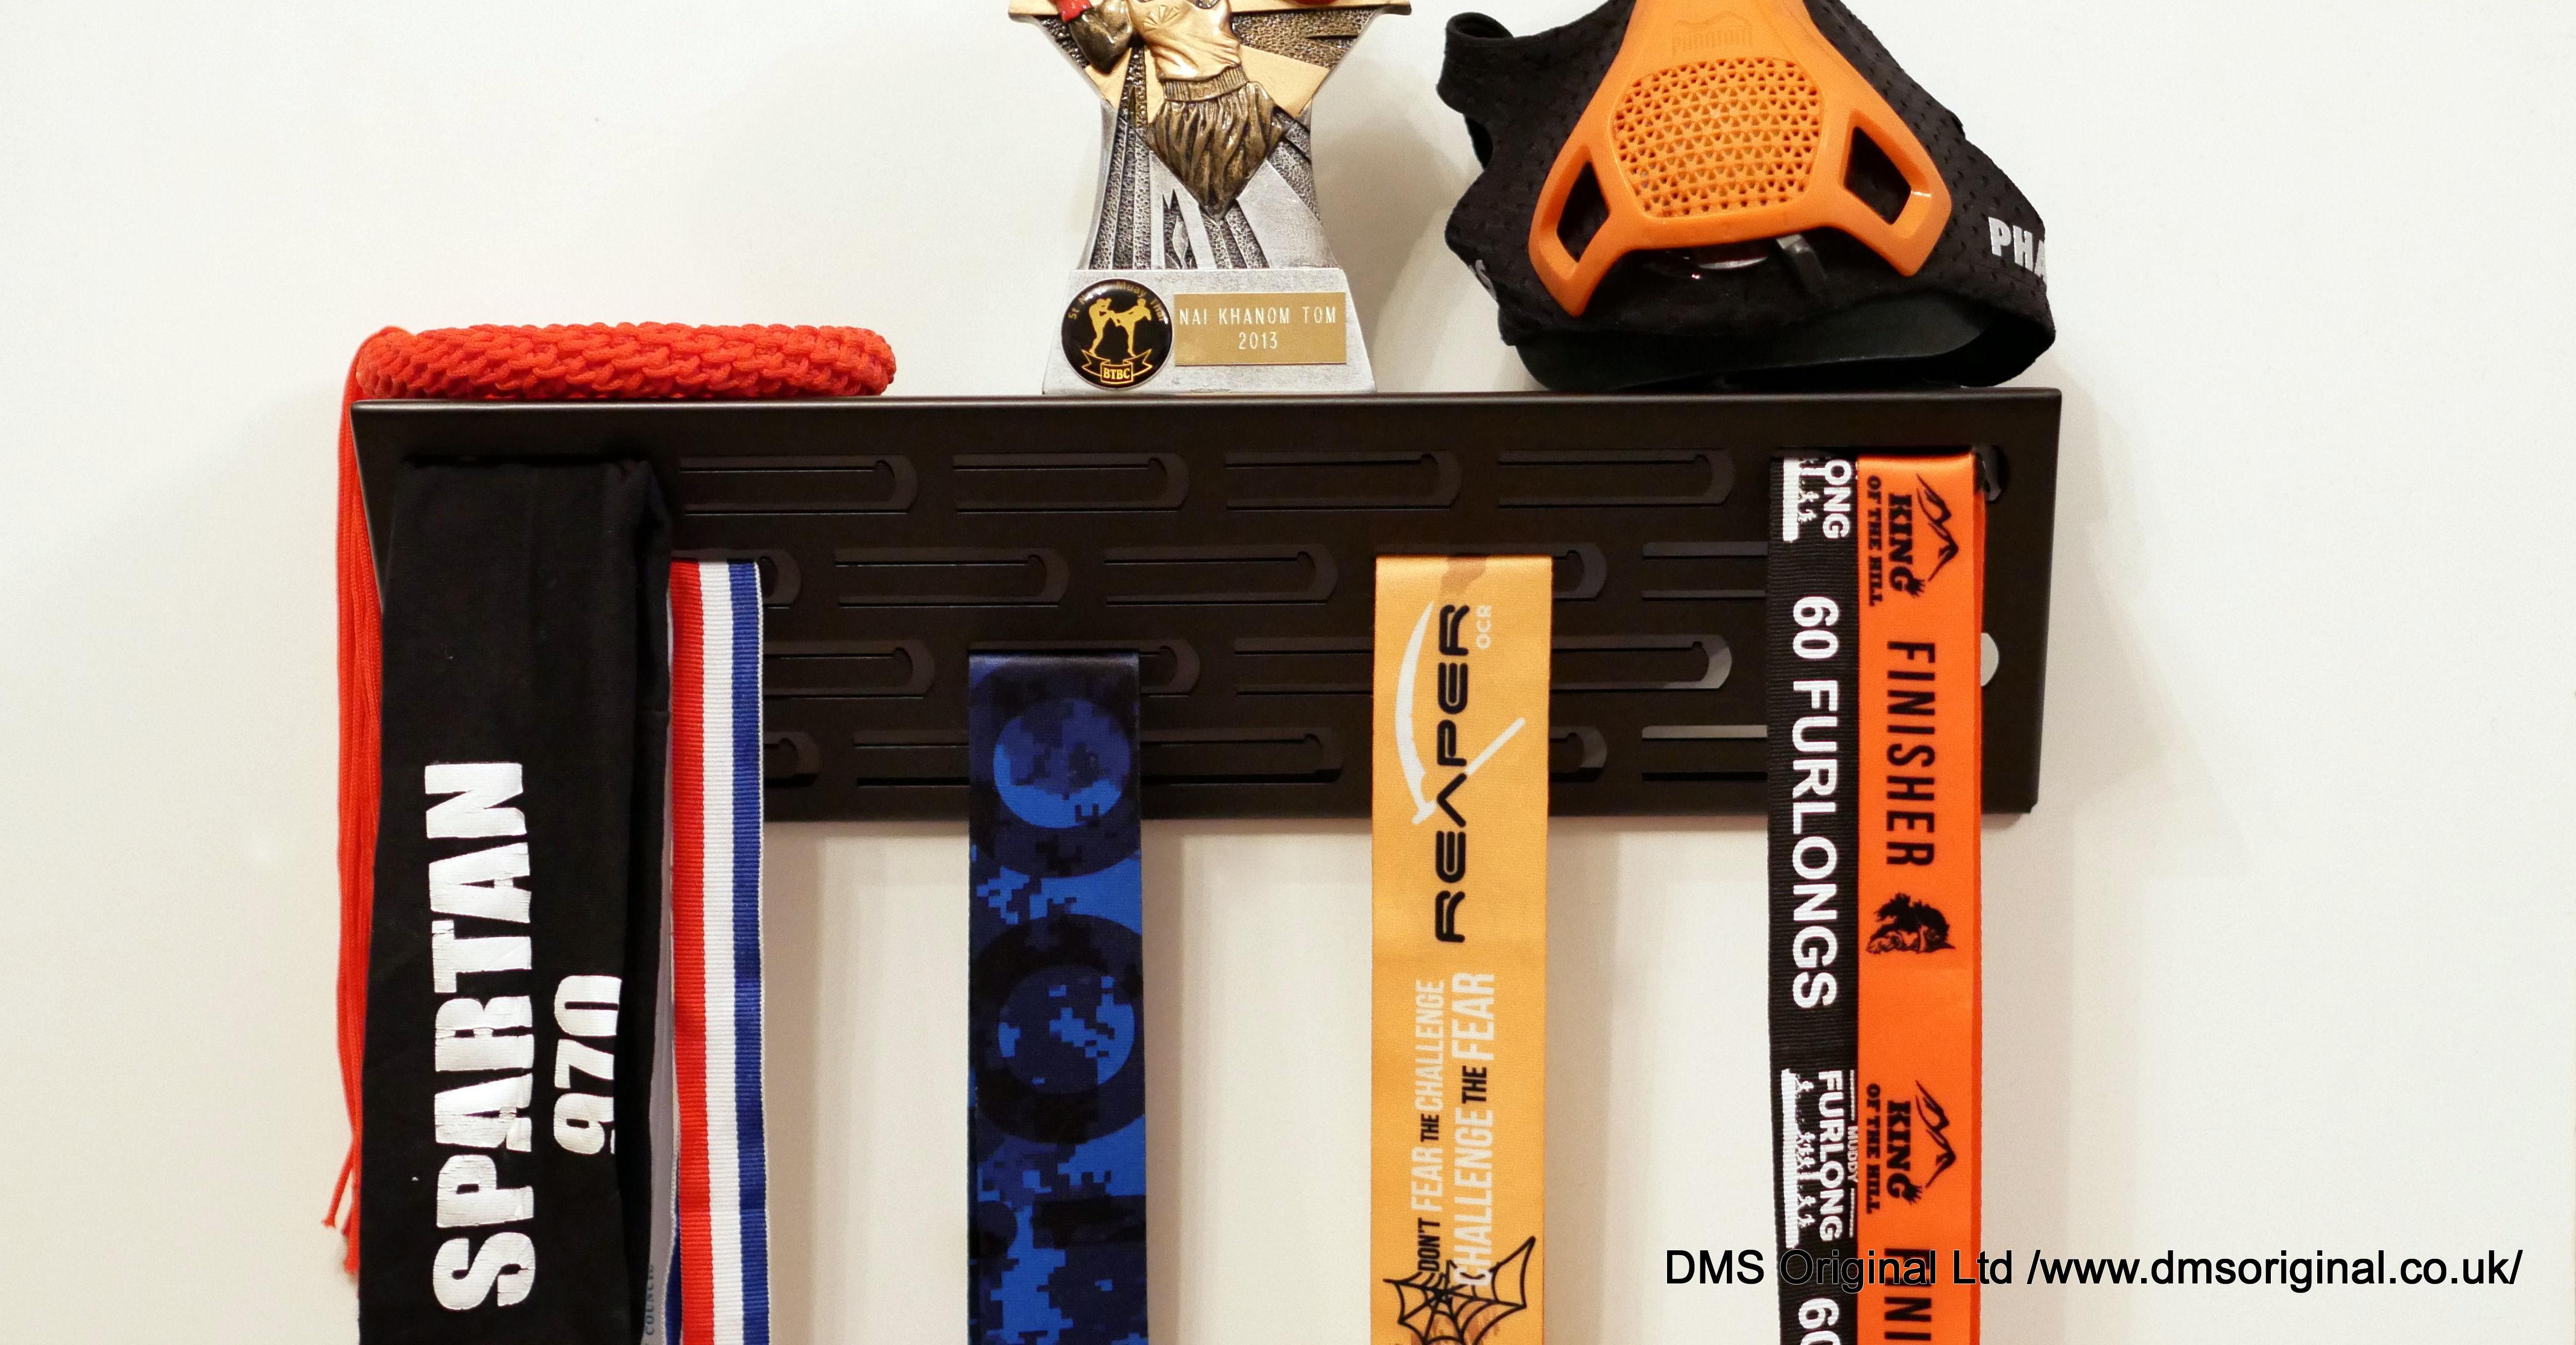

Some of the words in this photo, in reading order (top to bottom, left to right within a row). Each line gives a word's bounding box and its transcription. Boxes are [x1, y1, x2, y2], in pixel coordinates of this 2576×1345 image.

[1116, 281, 1147, 298] Muay
[1150, 297, 1165, 321] Thai
[1179, 307, 1207, 325] NAI
[1218, 306, 1290, 325] KHANOM
[1302, 306, 1337, 324] TOM
[1238, 331, 1279, 350] 2013
[1103, 368, 1130, 379] BTBC
[1867, 475, 1881, 505] OF
[1867, 508, 1882, 549] THE
[1889, 493, 1920, 595] KING
[1867, 555, 1882, 606] HILL
[1475, 605, 1492, 650] OCR
[1793, 596, 1839, 659] 60
[1434, 604, 1470, 943] REAPER
[1886, 641, 1935, 866] FINISHER
[1792, 680, 1839, 1008] FURLONGS
[425, 761, 536, 1311] SPARTAN
[1451, 972, 1495, 1061] FEAR
[553, 975, 622, 1154] 970
[1414, 979, 1445, 1112] CHALLENGE
[1461, 1065, 1487, 1104] THE
[1867, 1083, 1881, 1110] OF
[1420, 1113, 1440, 1142] THE
[1847, 1125, 1859, 1183] MUDDY
[1867, 1116, 1881, 1159] THE
[1887, 1100, 1917, 1202] KING
[1411, 1146, 1444, 1212] FEAR
[1818, 1070, 1844, 1242] FURLONG
[1452, 1107, 1493, 1286] CHALLENGE
[1867, 1165, 1881, 1214] HILL
[1417, 1217, 1441, 1272] DON'T
